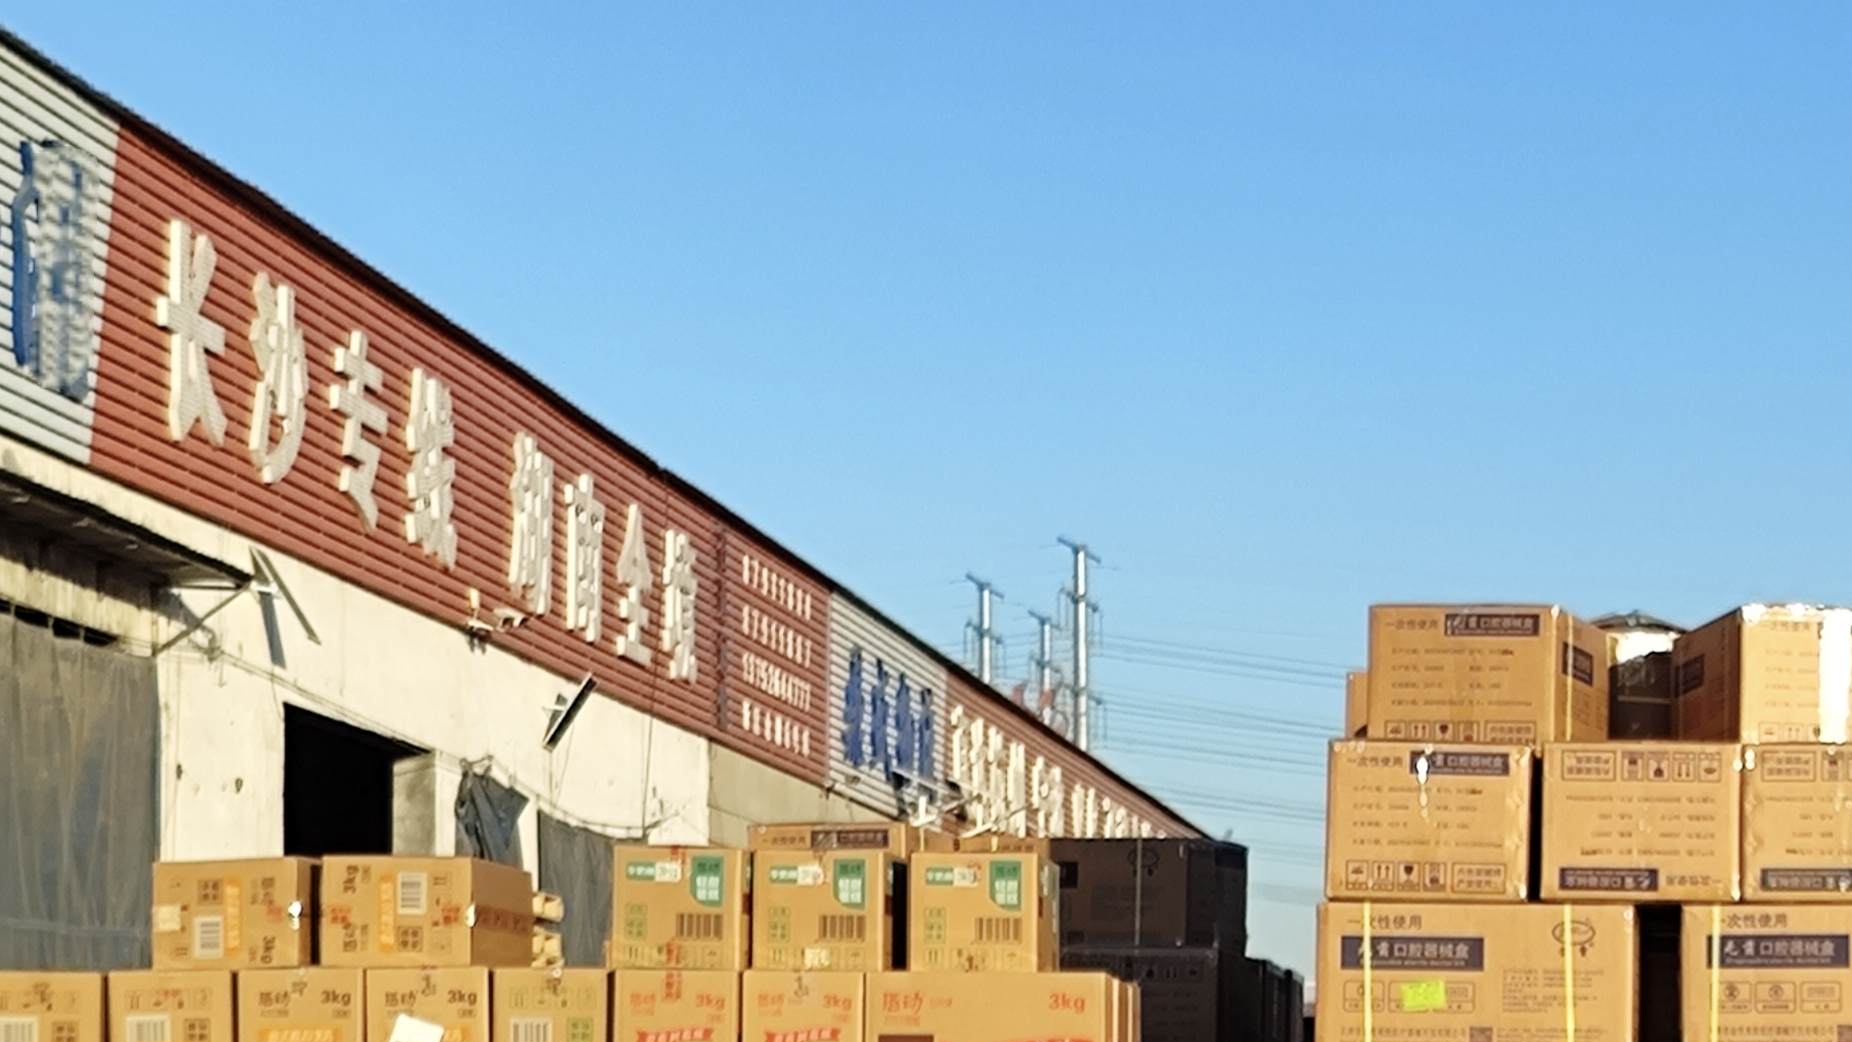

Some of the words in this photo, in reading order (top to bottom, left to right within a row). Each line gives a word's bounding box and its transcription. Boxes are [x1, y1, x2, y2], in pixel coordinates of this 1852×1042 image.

[156, 219, 457, 571] 长沙专线
[1722, 914, 1788, 929] 次性使用
[321, 990, 351, 1006] 3kg
[448, 989, 478, 1005] 3kg
[822, 993, 852, 1011] 3kg
[1049, 993, 1085, 1013] 3kg
